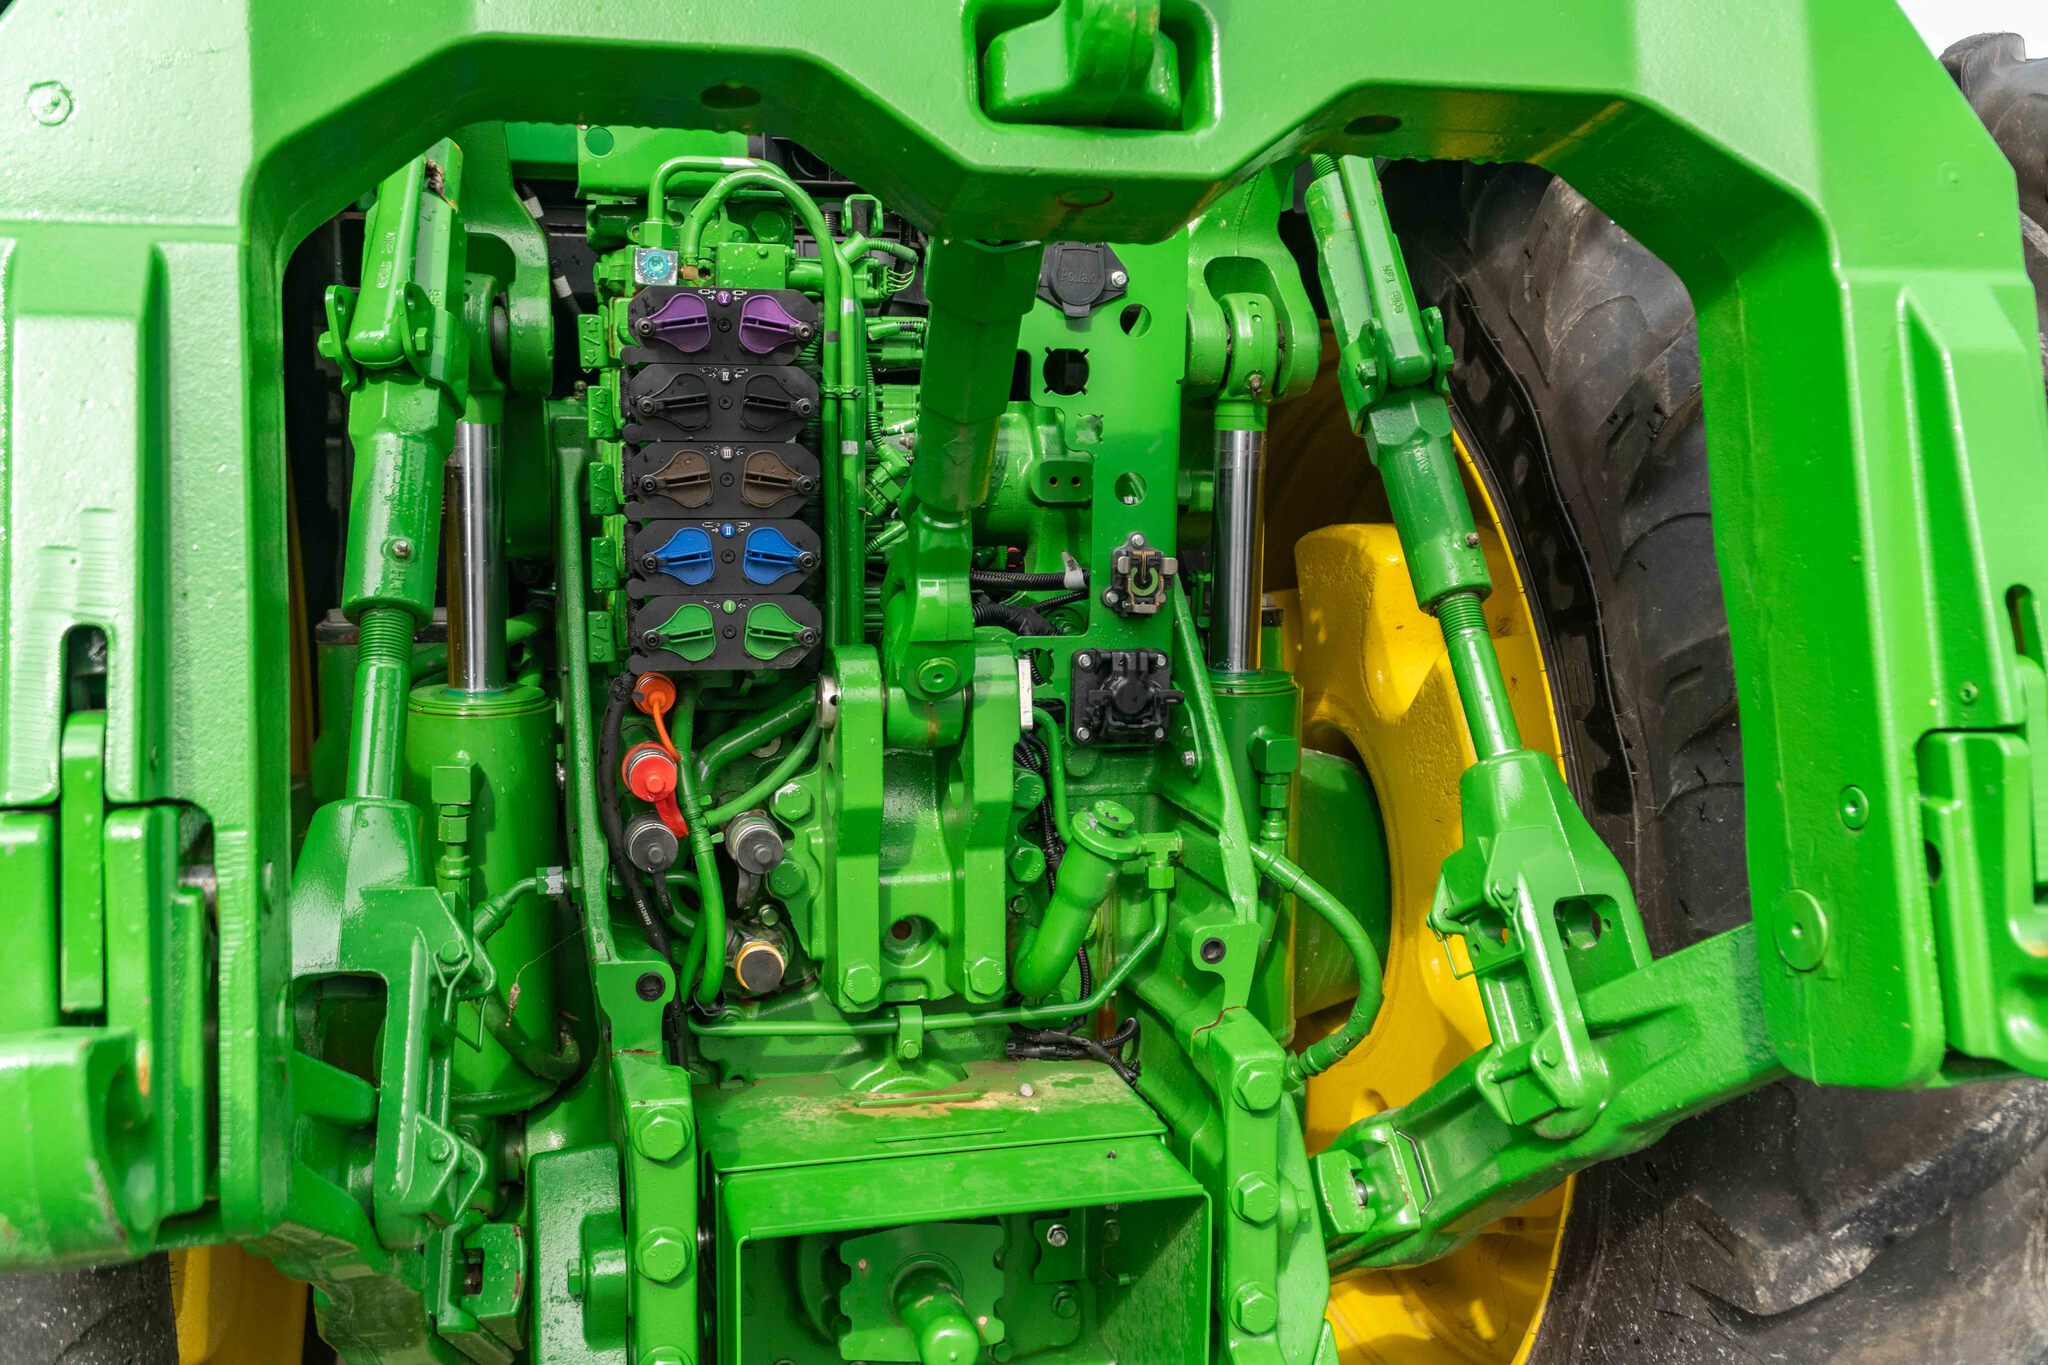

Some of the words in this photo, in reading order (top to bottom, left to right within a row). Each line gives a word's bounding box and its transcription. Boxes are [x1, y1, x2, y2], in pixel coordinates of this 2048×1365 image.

[1060, 268, 1097, 284] Pollak
[720, 293, 728, 303] V
[722, 371, 730, 381] IV
[723, 449, 732, 459] III
[725, 526, 732, 536] II
